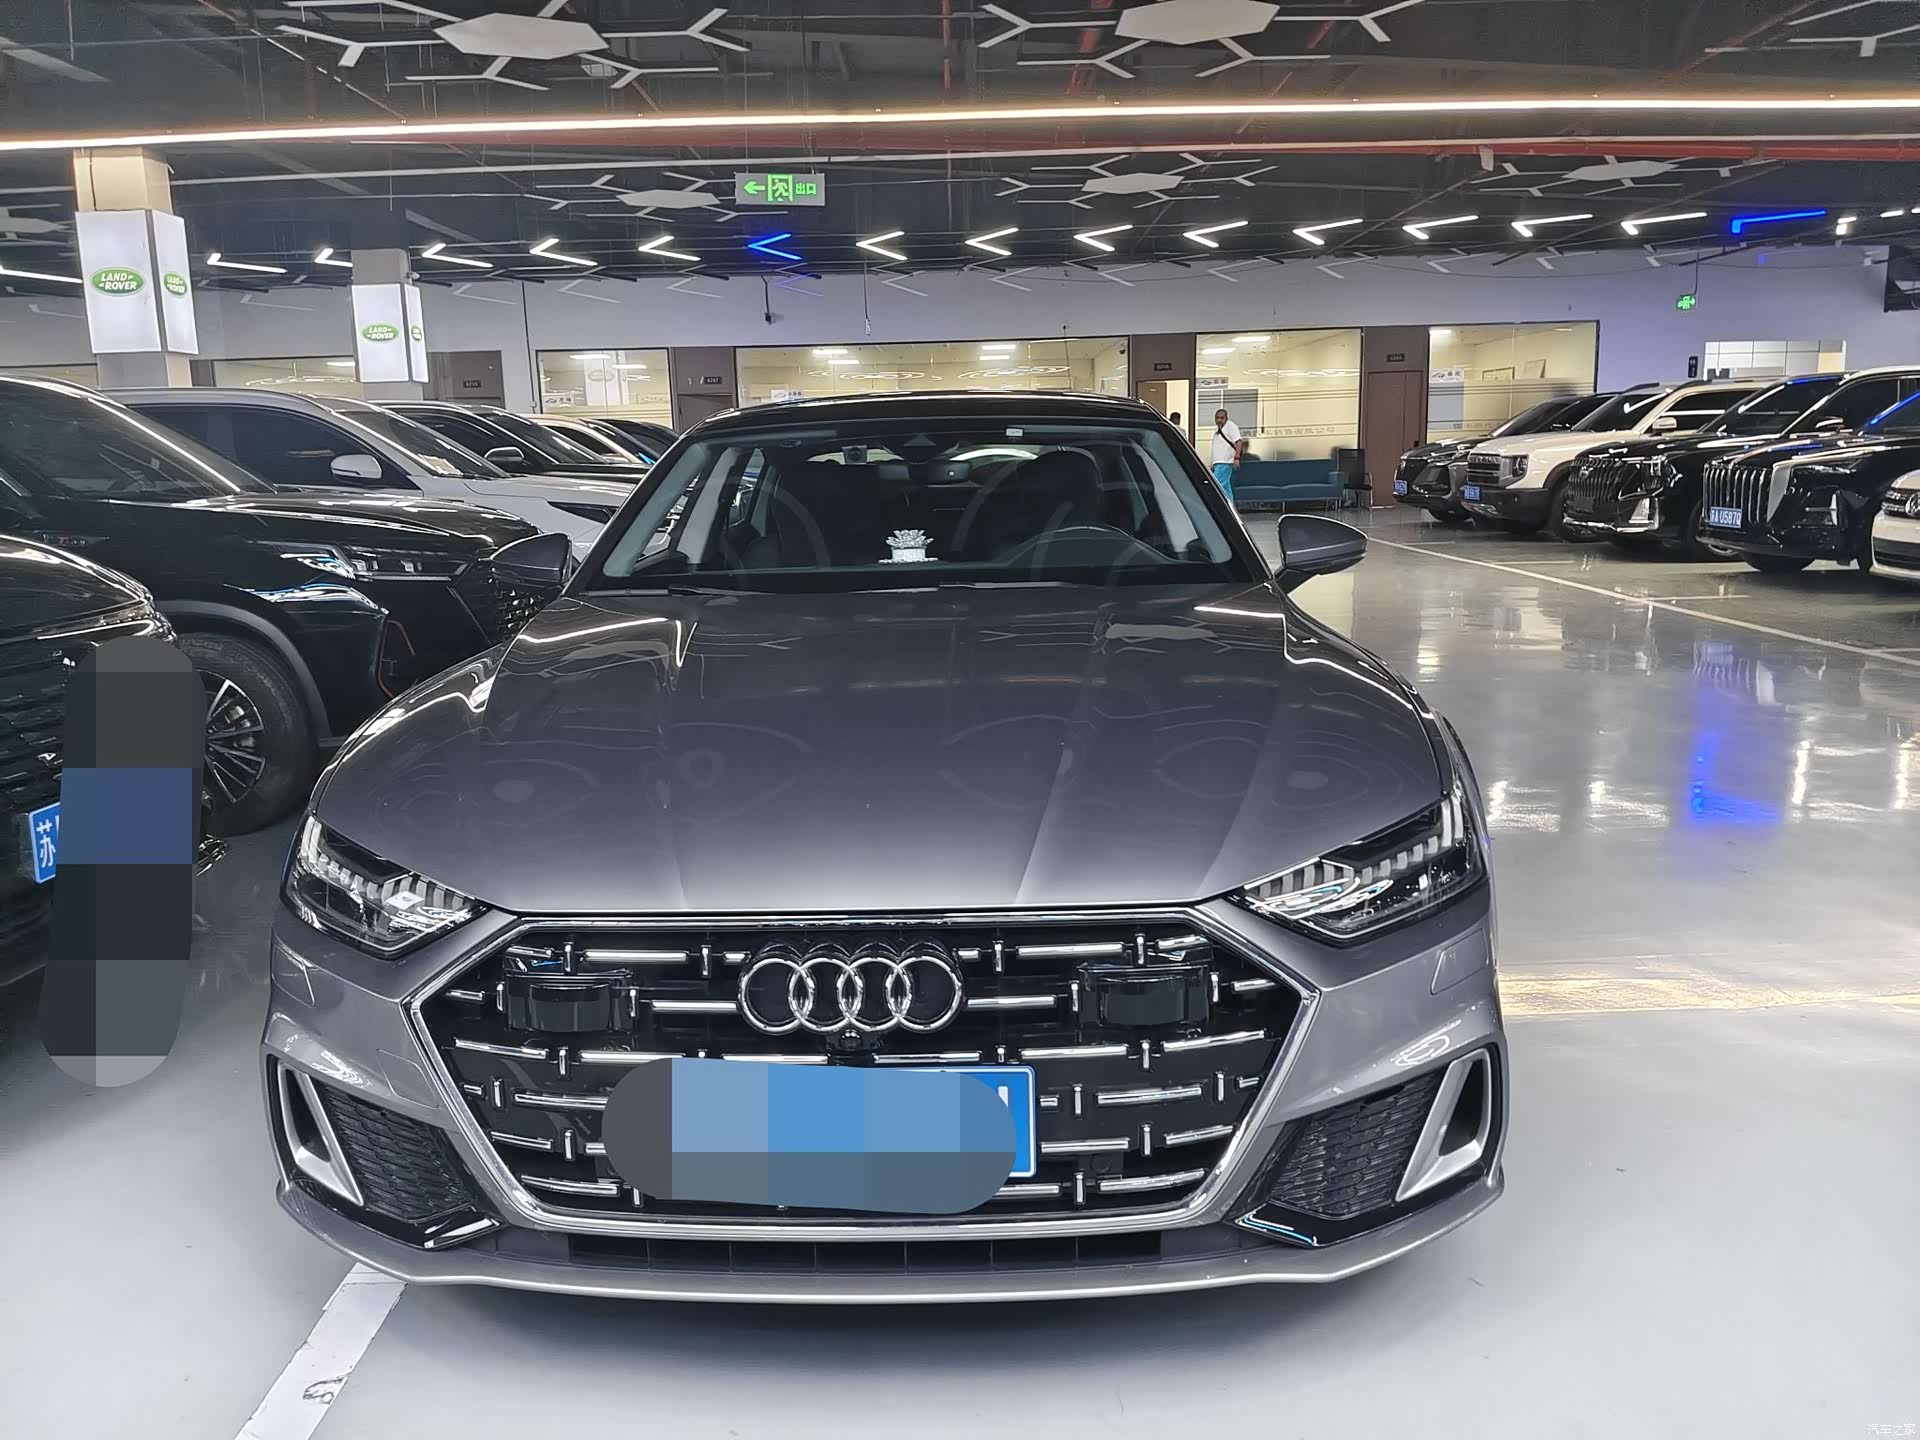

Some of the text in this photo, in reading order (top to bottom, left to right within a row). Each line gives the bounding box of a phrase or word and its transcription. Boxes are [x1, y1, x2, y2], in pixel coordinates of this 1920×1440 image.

[795, 182, 817, 195] 出口
[101, 272, 127, 281] LAND
[104, 281, 138, 290] ROVER
